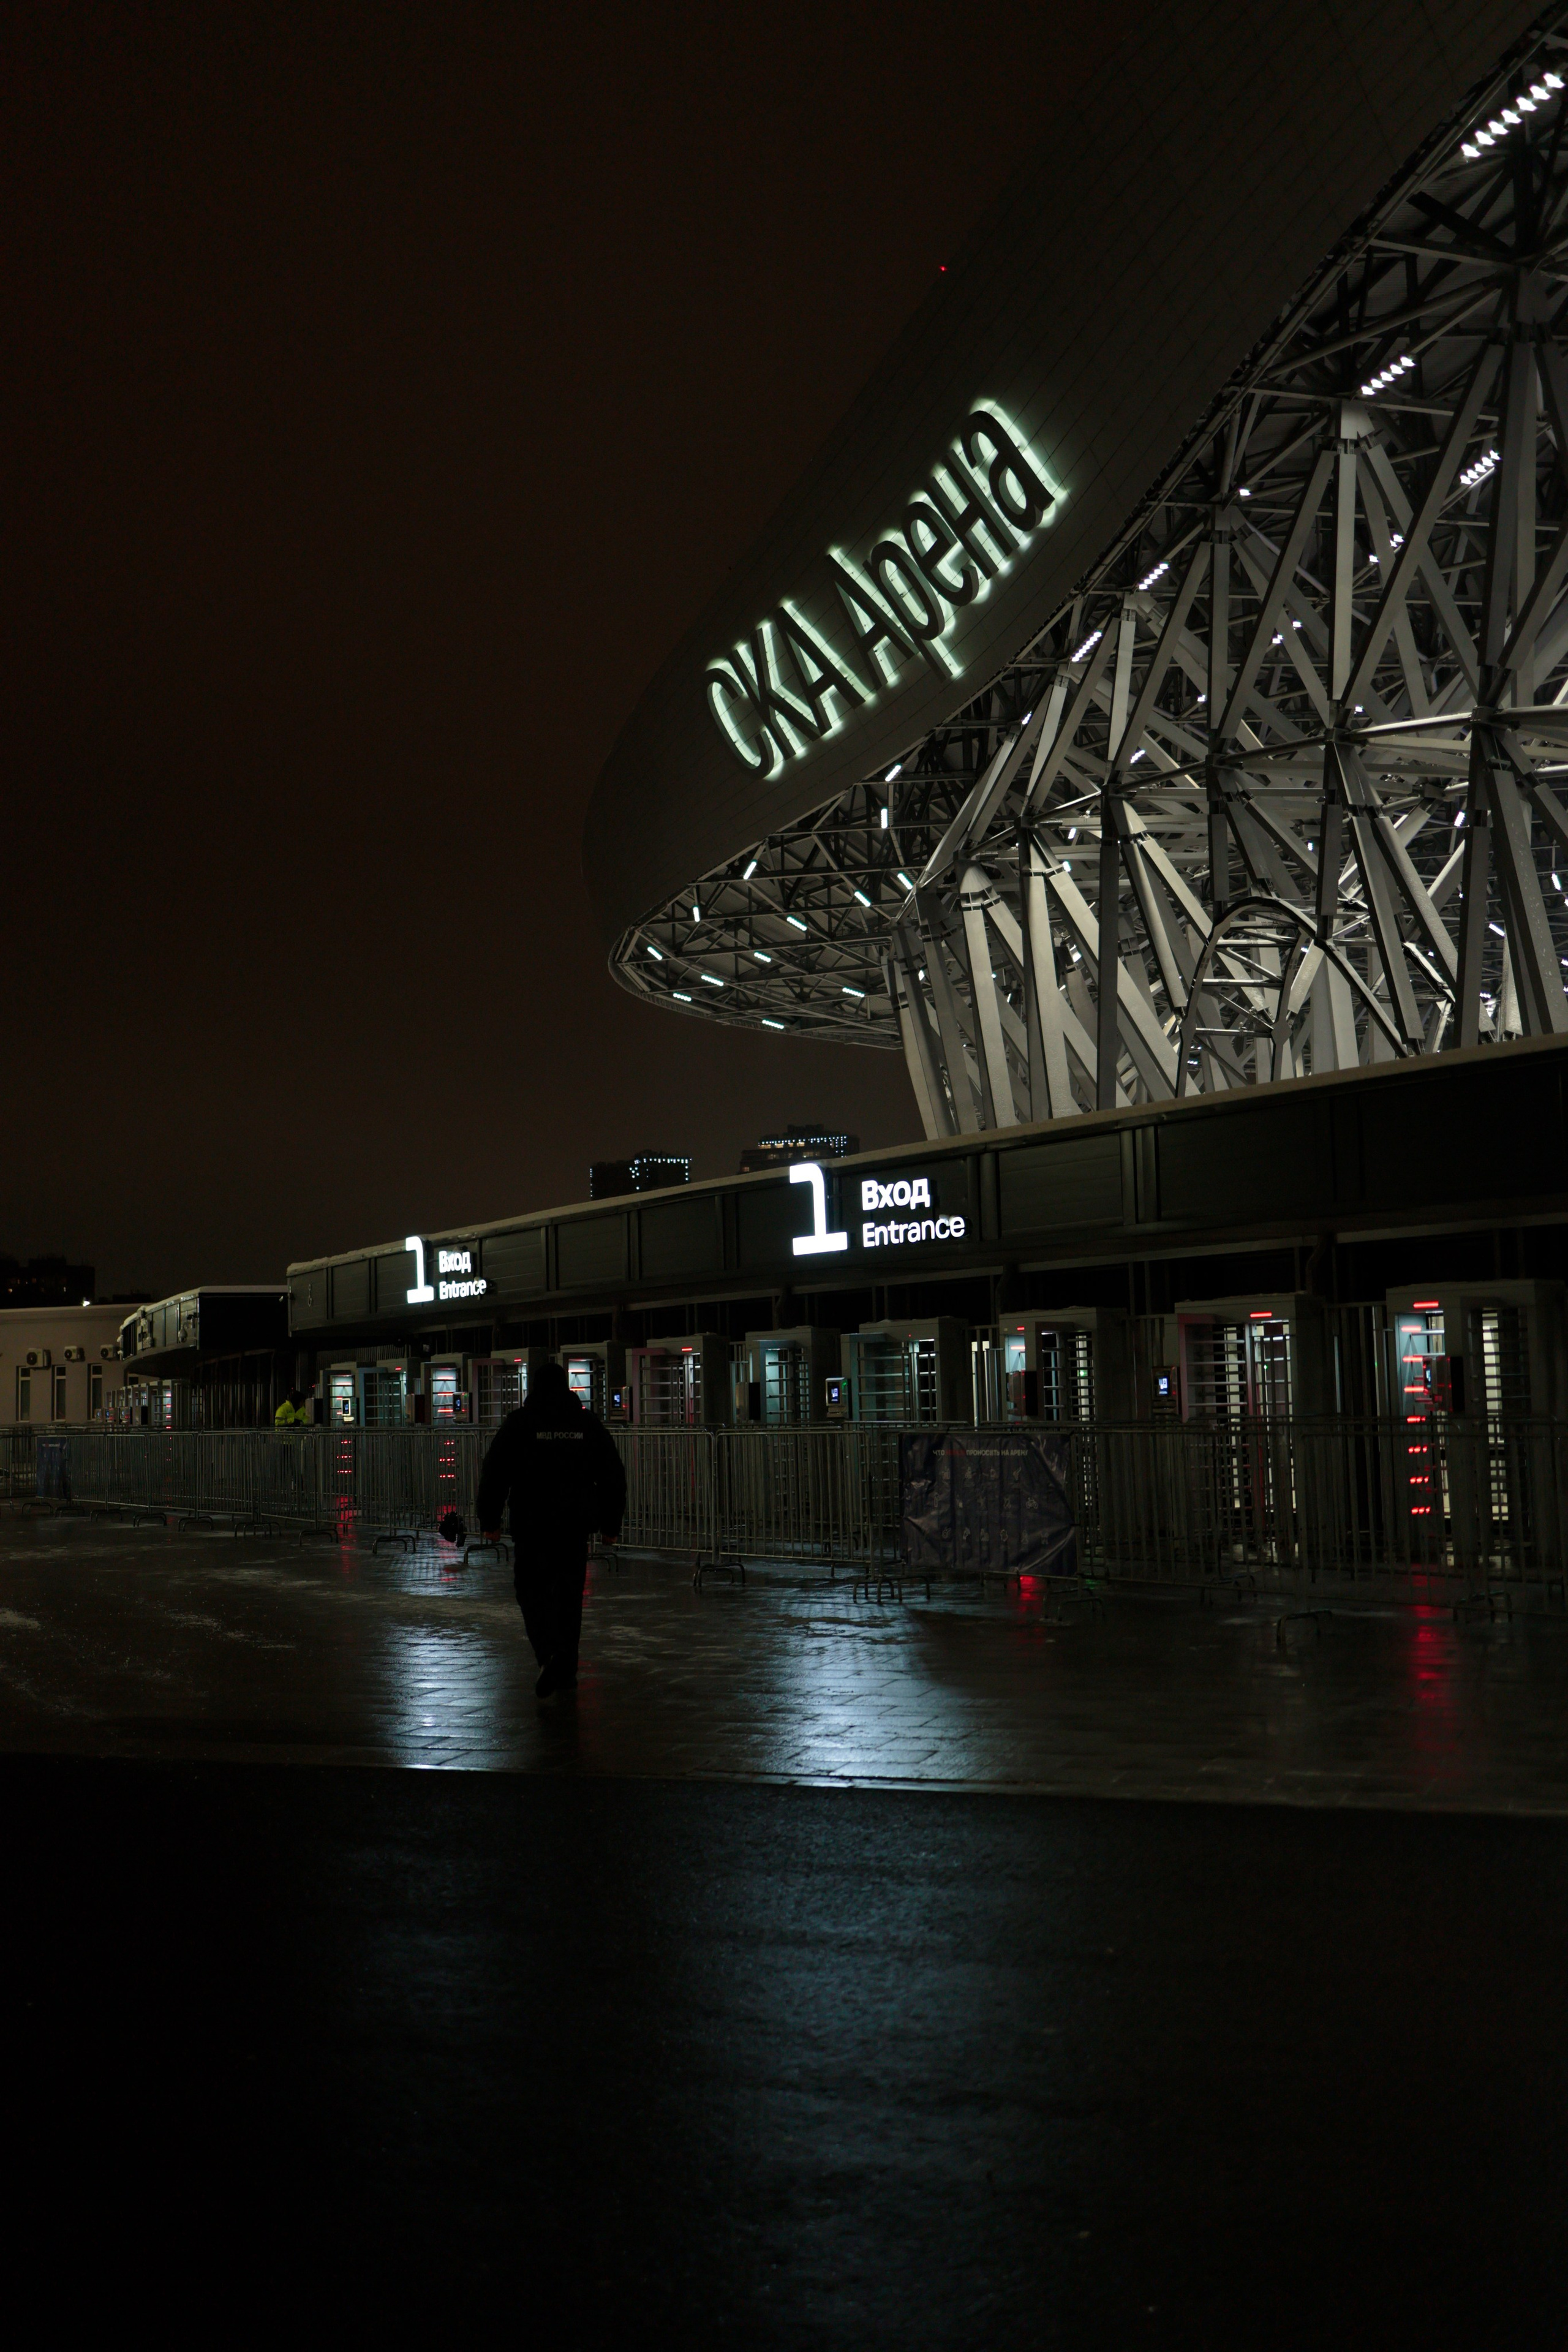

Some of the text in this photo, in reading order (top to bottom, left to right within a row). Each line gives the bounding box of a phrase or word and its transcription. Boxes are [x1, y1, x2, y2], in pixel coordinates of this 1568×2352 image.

[705, 409, 1056, 780] СКА Арена
[790, 1163, 848, 1256] 1
[861, 1178, 930, 1211] Вход
[862, 1216, 965, 1248] Entrance
[405, 1236, 434, 1303] 1
[439, 1251, 471, 1273] Вход
[439, 1279, 487, 1300] Entrance
[536, 1431, 584, 1440] МВД РОССИИ
